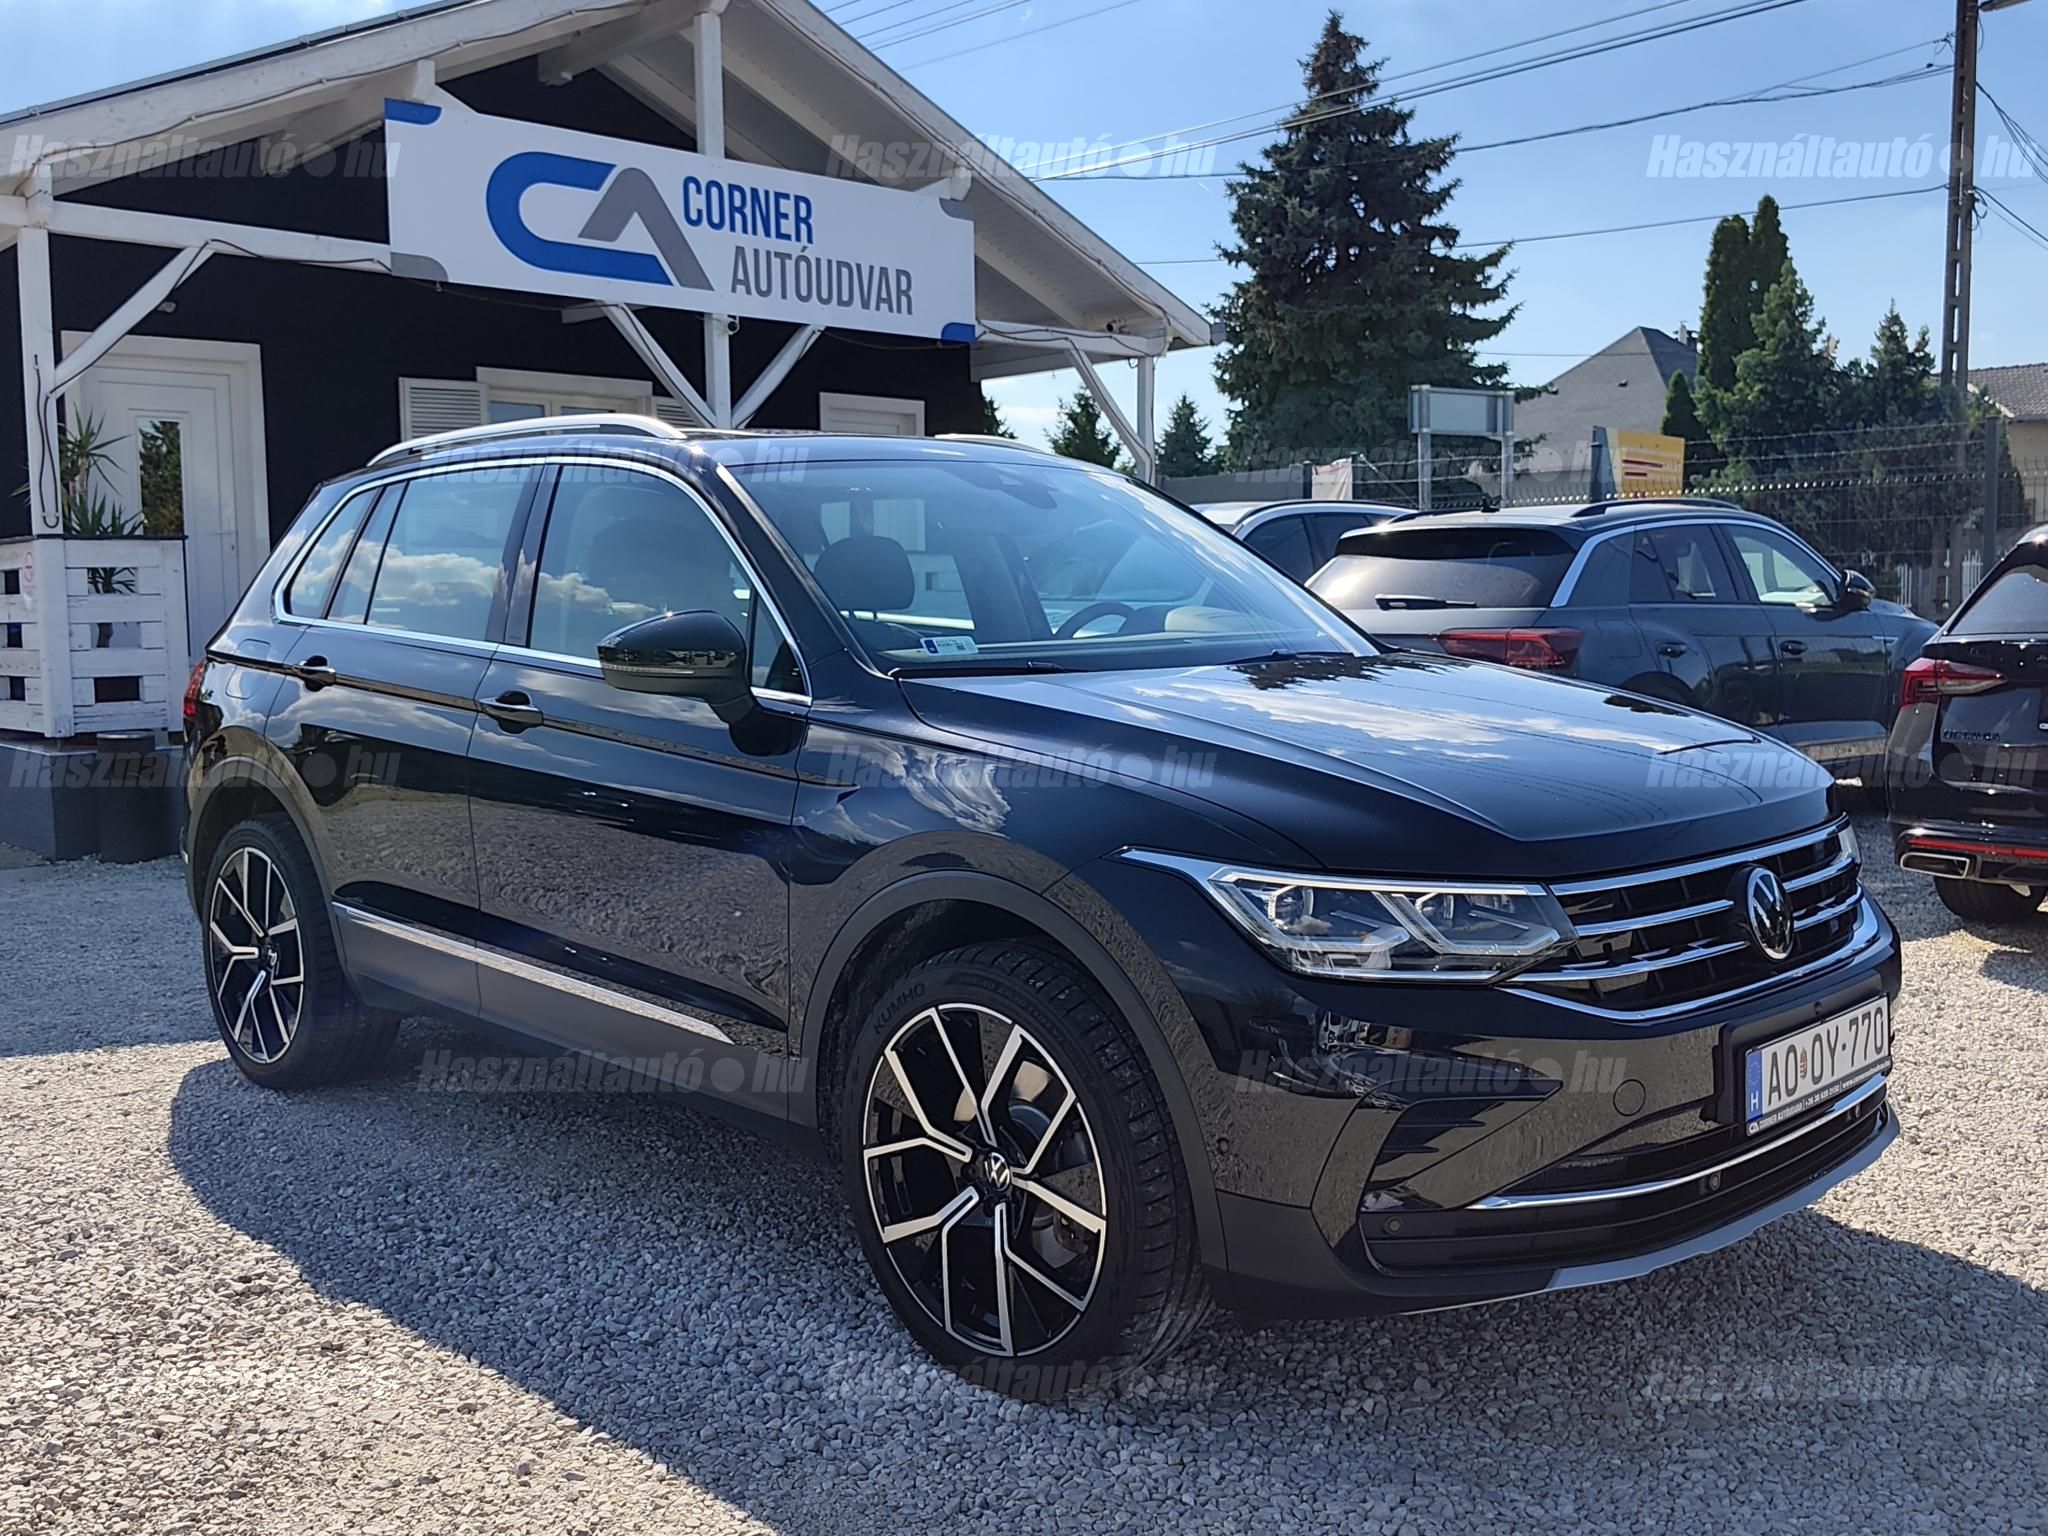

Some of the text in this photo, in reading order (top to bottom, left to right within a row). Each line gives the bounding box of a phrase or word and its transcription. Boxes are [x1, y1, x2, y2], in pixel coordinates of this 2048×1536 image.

[682, 175, 814, 244] CORNER
[731, 244, 914, 316] AUTÓUDVAR
[872, 982, 926, 1034] KUMHO
[1750, 1090, 1759, 1112] H
